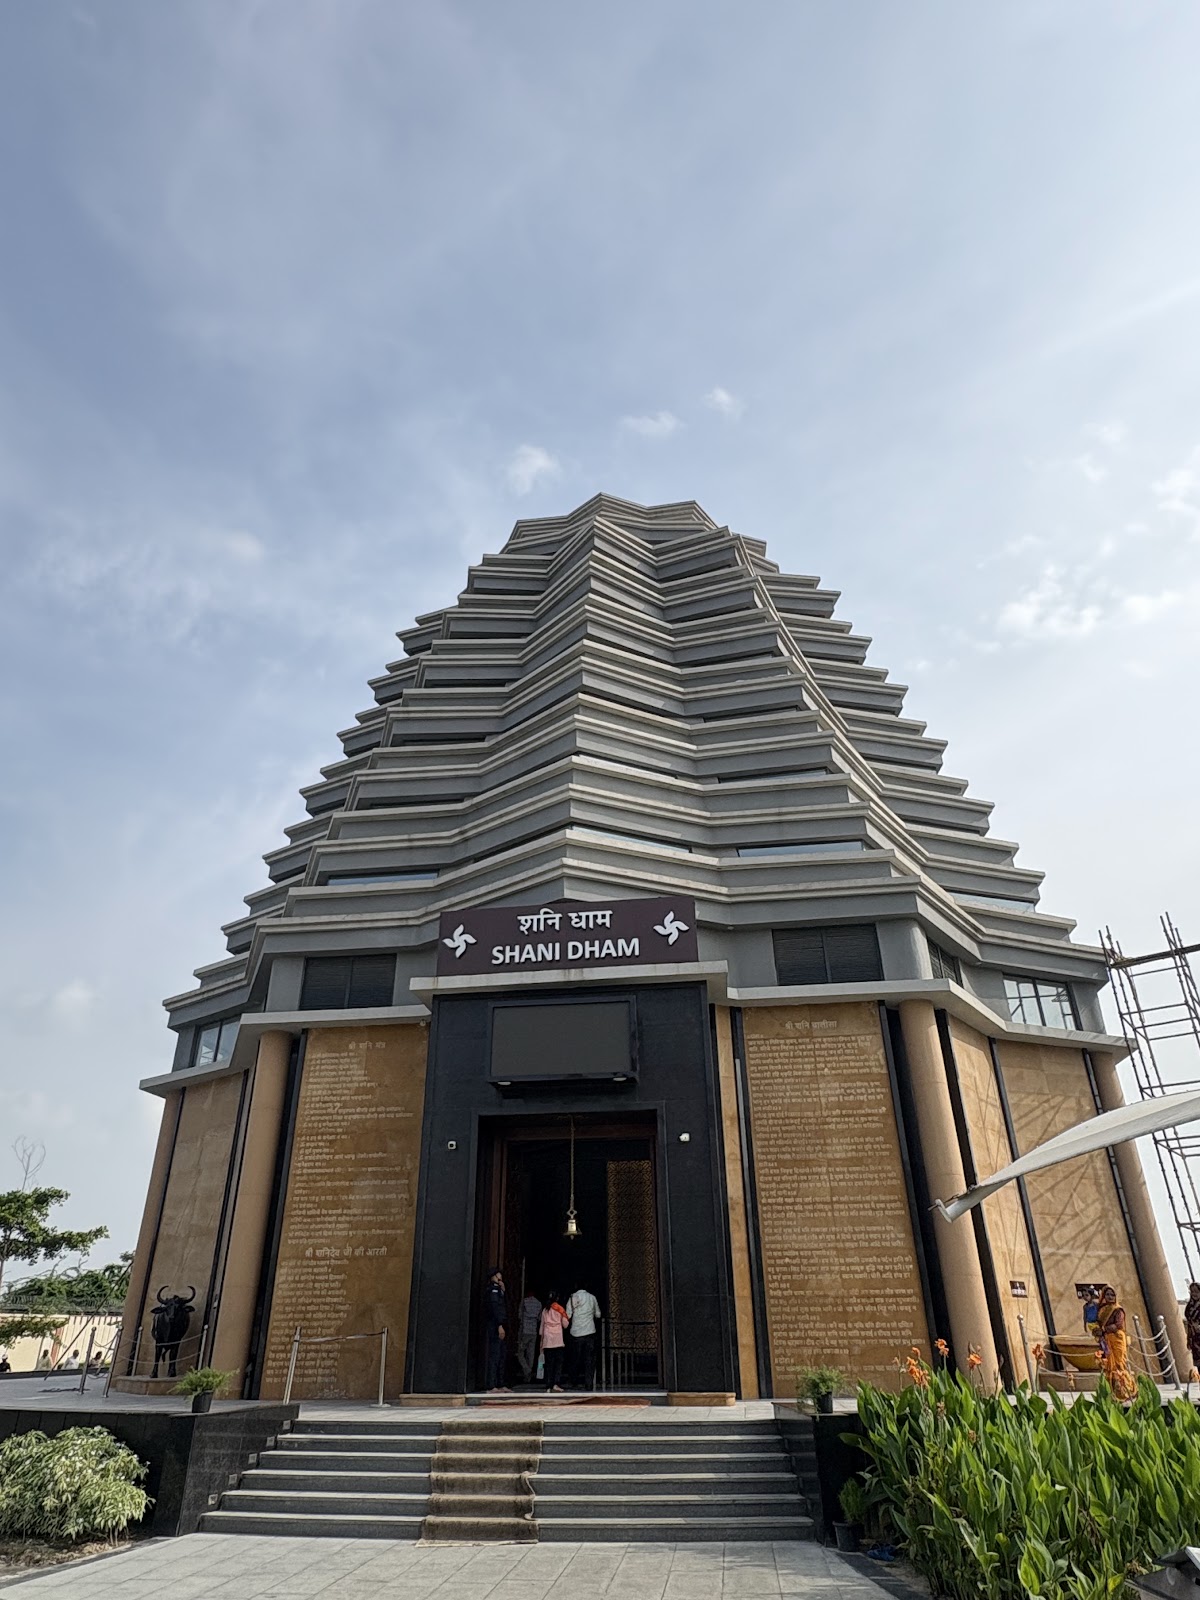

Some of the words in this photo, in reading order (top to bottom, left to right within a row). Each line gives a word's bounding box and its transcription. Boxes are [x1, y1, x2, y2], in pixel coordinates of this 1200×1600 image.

[517, 908, 562, 935] शनि
[568, 910, 613, 930] धाम
[491, 942, 560, 965] SHANI
[567, 938, 640, 960] DHAM
